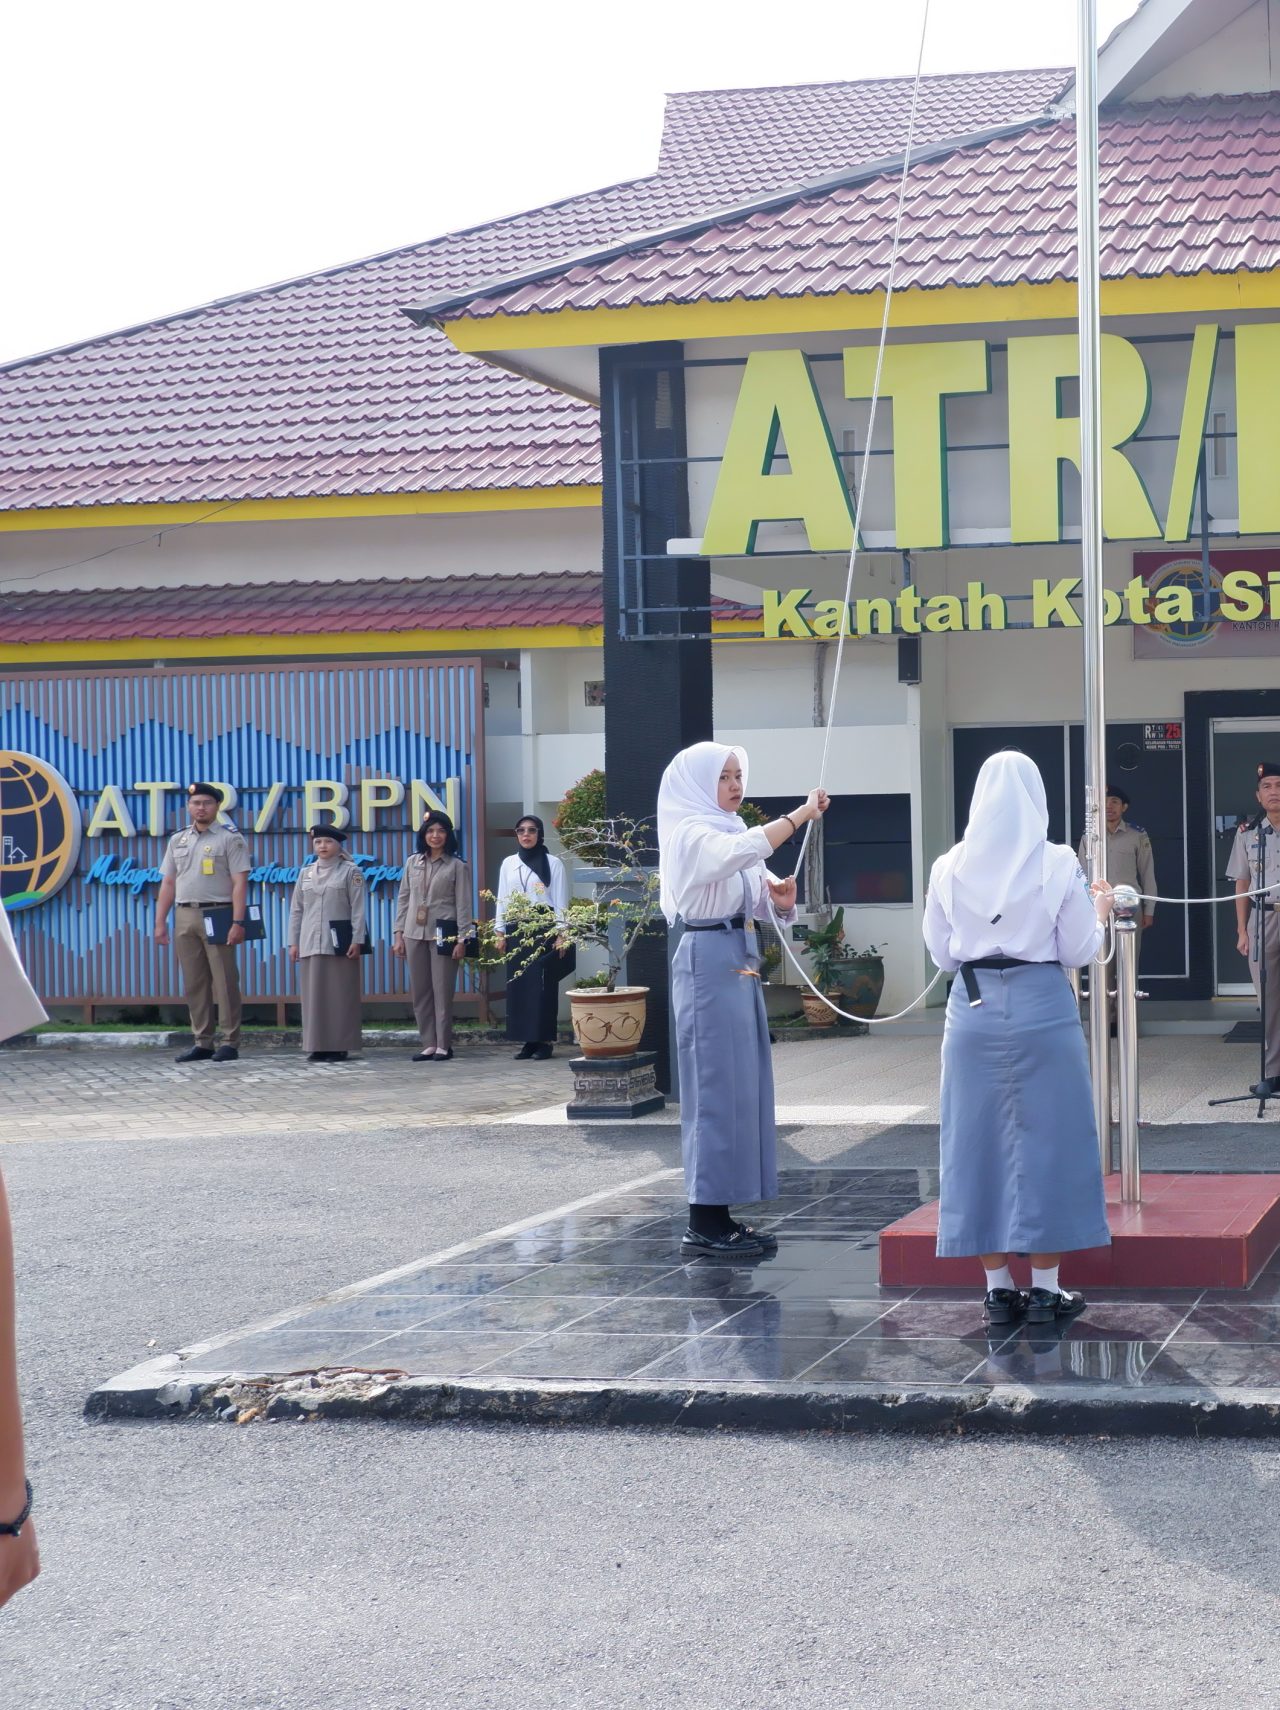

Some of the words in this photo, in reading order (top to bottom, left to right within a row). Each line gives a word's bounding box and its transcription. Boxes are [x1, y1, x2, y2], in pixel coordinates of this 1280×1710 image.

[763, 580, 1006, 638] Kantah
[1231, 620, 1271, 632] KANTOR
[1166, 724, 1182, 739] 25
